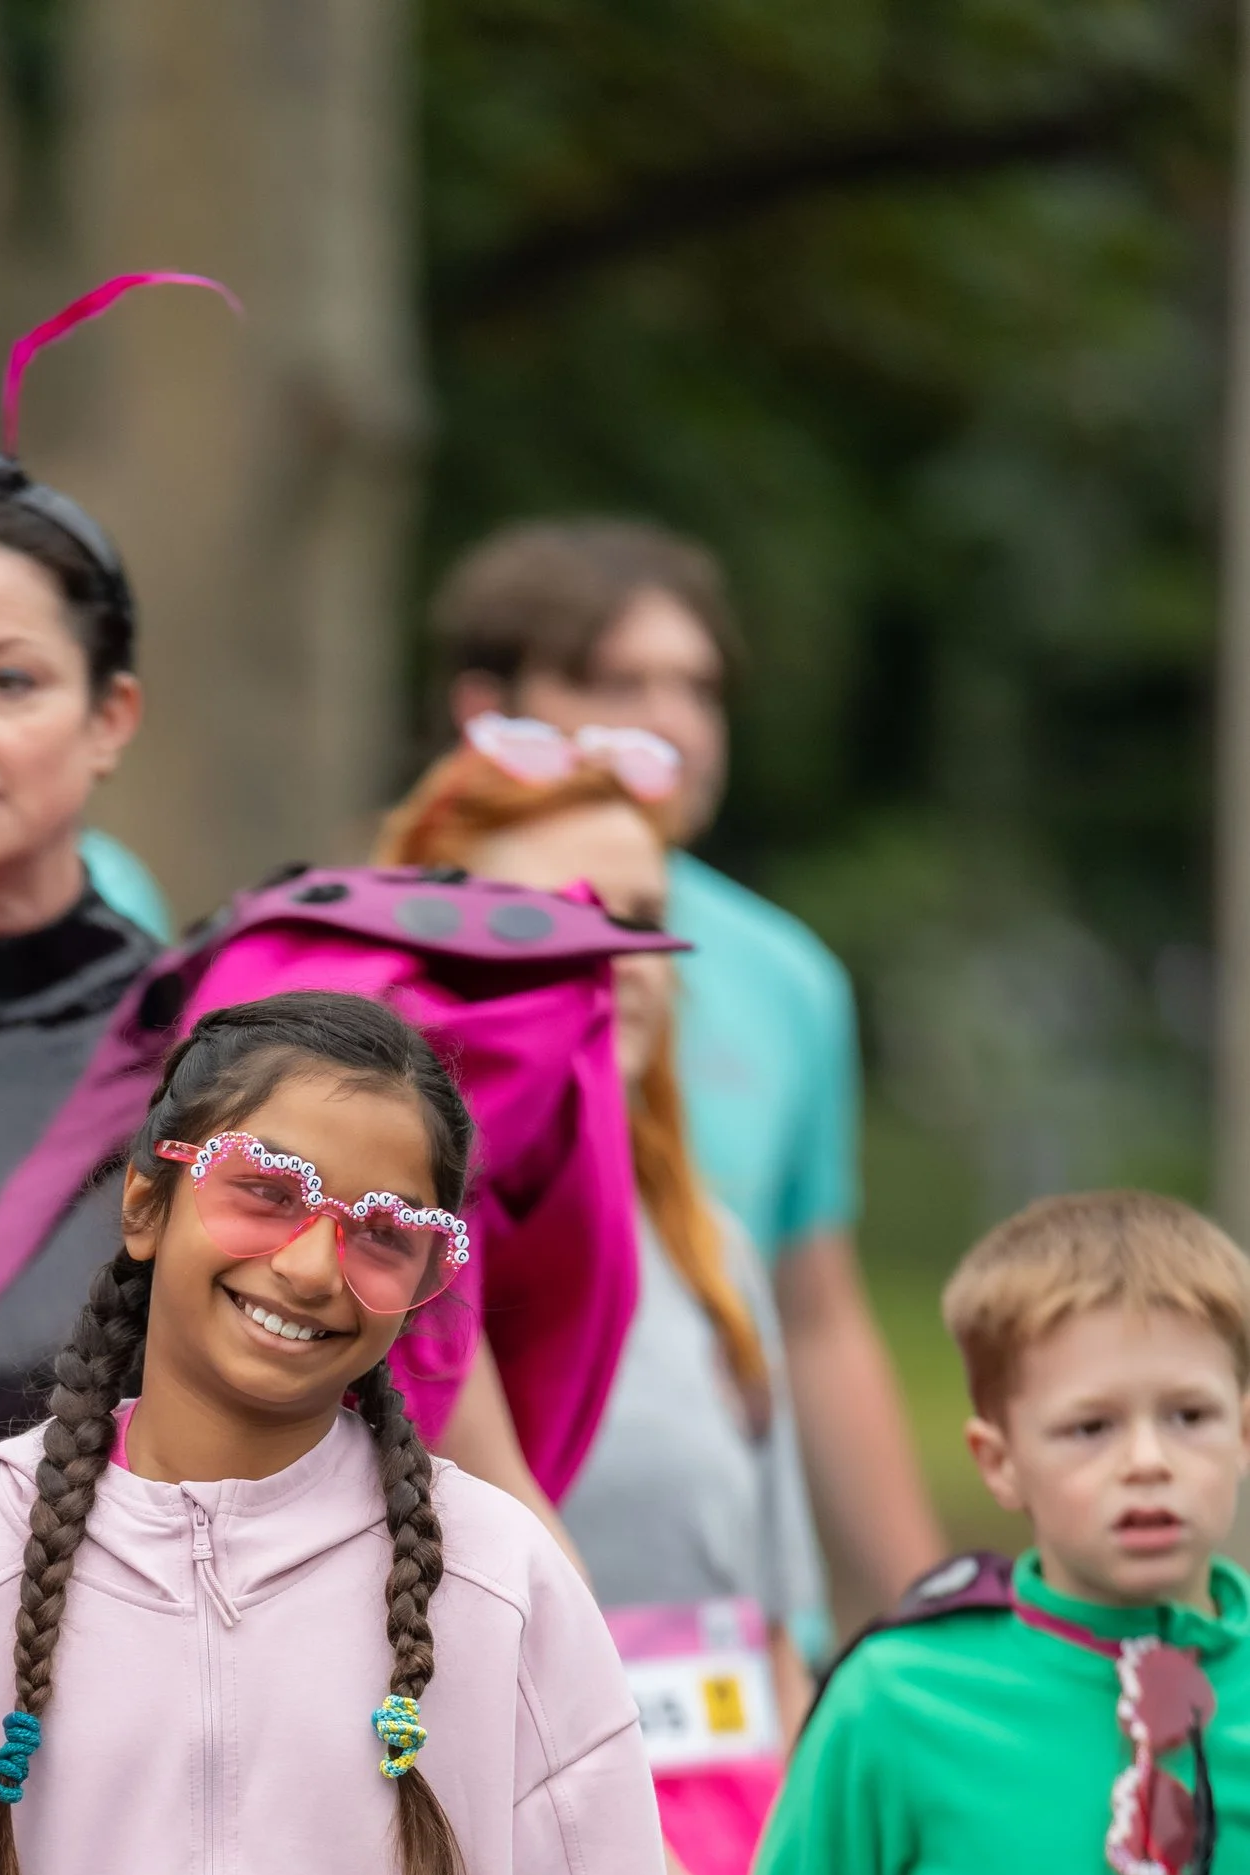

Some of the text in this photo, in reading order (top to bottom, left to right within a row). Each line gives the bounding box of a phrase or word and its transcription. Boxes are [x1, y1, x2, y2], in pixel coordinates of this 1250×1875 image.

[193, 1140, 468, 1263] THE MOTHERS DAY CLASSIC
